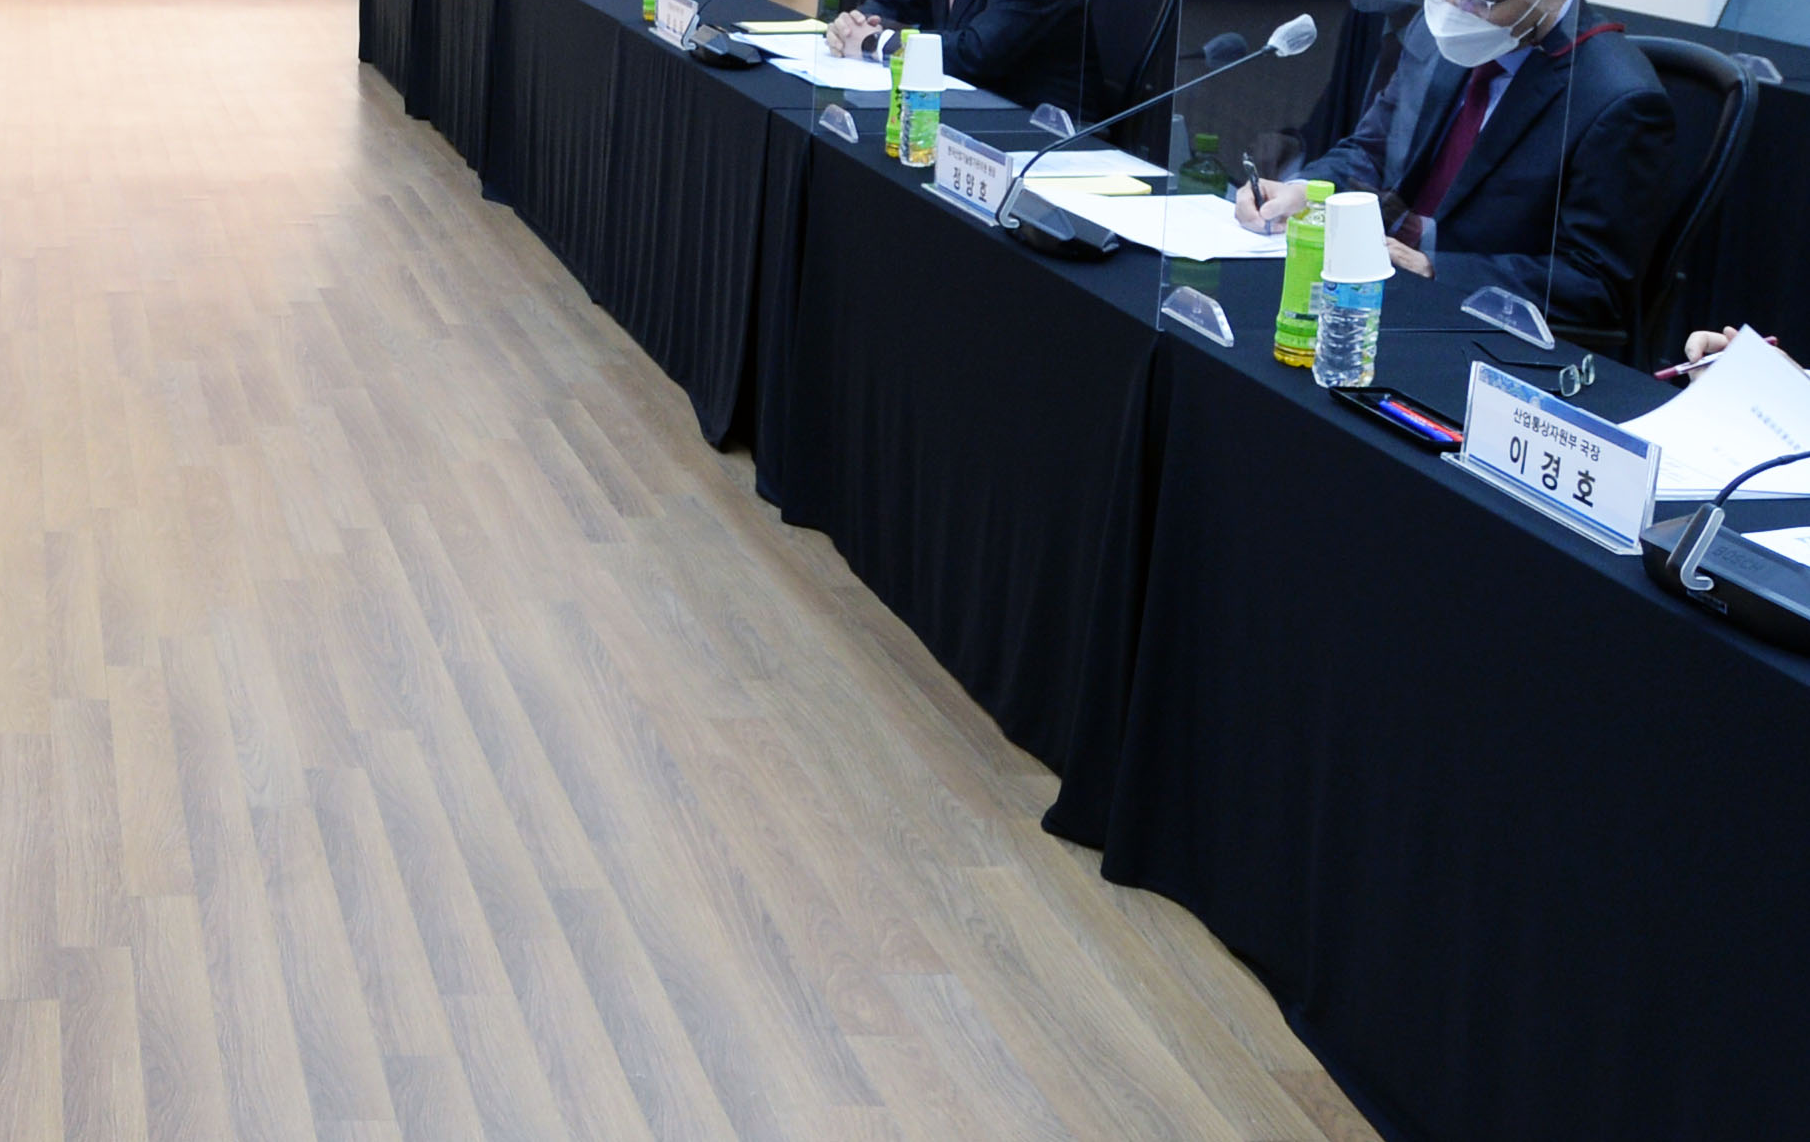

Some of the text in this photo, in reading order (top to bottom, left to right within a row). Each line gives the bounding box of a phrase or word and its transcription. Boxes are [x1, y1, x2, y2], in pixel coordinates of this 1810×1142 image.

[1513, 407, 1601, 462] 산업통상자원부 국장
[1509, 435, 1596, 508] 이경호
